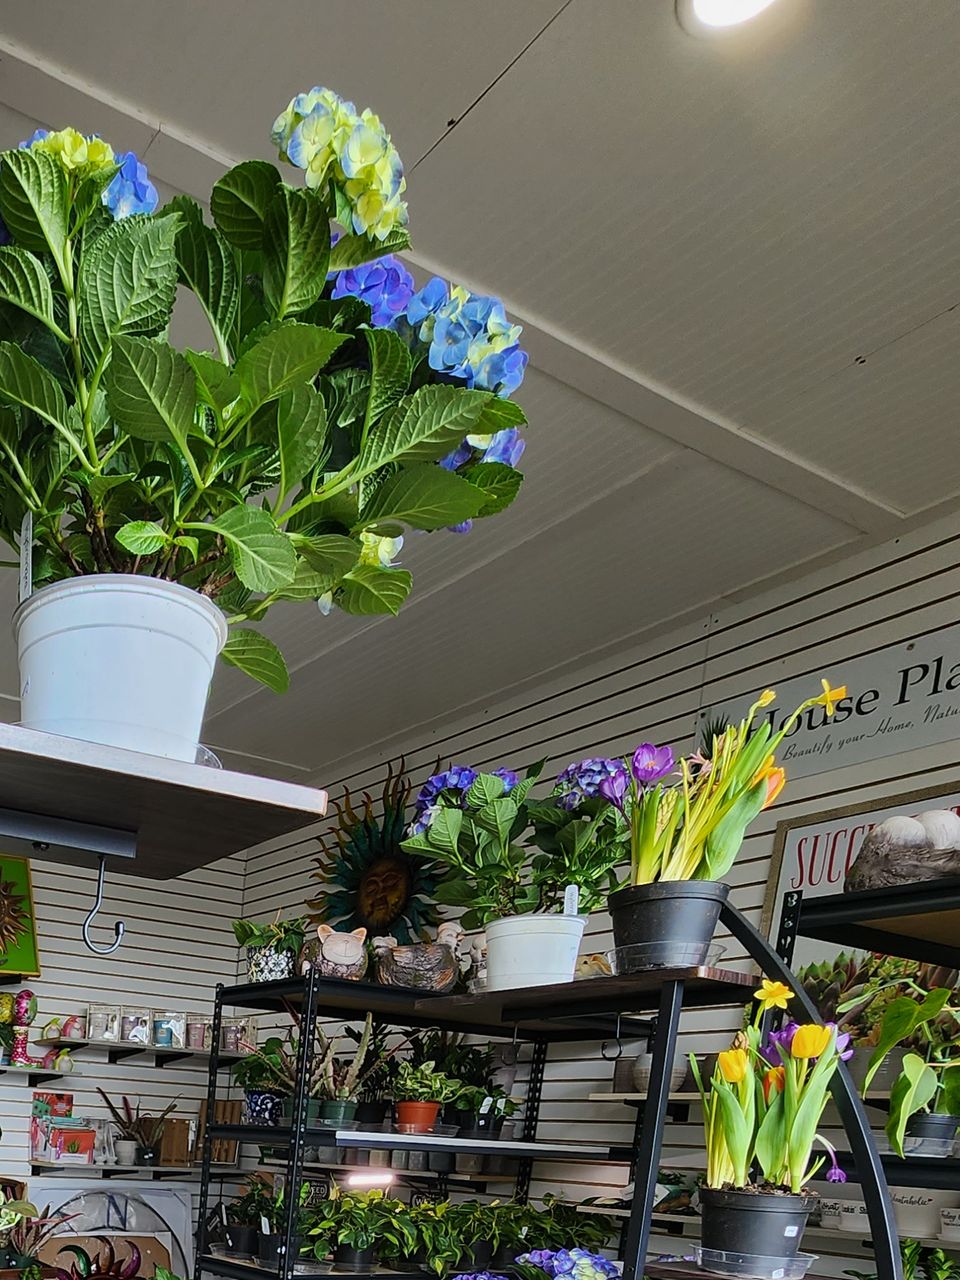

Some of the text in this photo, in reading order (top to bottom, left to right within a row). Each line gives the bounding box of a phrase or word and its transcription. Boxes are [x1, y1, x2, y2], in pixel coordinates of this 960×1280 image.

[892, 655, 960, 706] Pla
[781, 734, 834, 761] Beautify
[838, 734, 866, 751] your
[790, 823, 877, 889] SUCC
